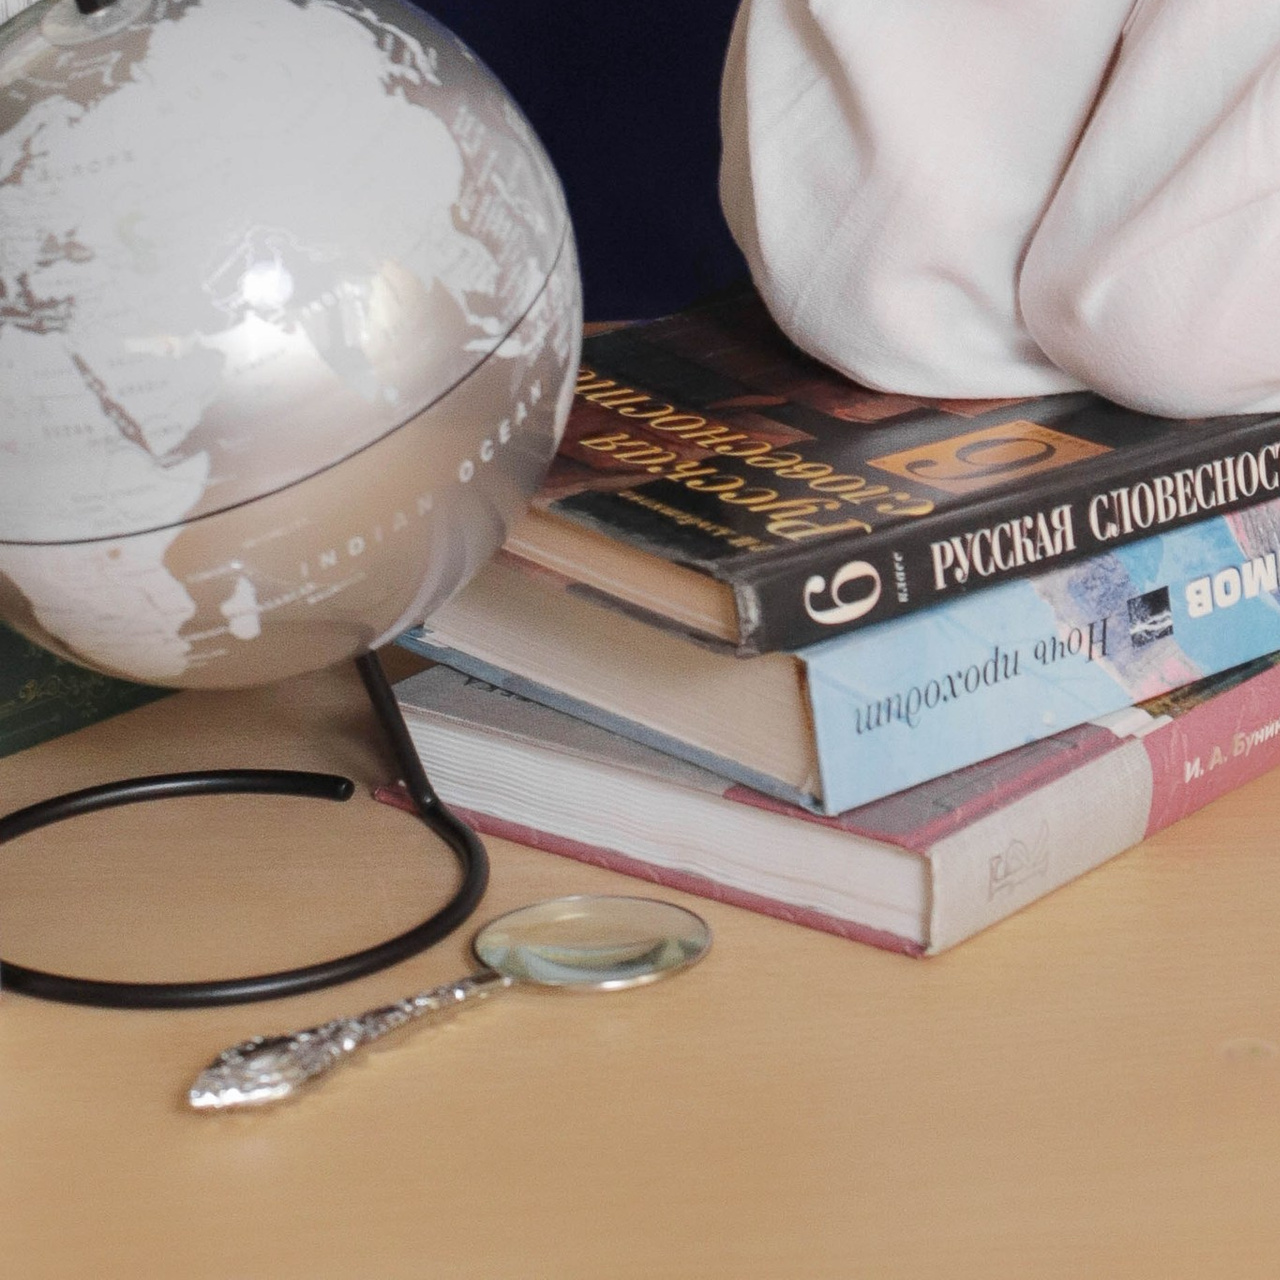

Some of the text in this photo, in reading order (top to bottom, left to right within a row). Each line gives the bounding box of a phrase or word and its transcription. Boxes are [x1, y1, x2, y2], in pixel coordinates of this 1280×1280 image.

[299, 378, 543, 579] INDIAN OCEAN
[578, 431, 873, 543] Русская
[803, 560, 882, 625] 6
[930, 503, 1077, 591] РУССКАЯ
[854, 616, 1112, 735] Ночь проходит
[1182, 758, 1205, 784] И.
[1208, 744, 1229, 772] А.
